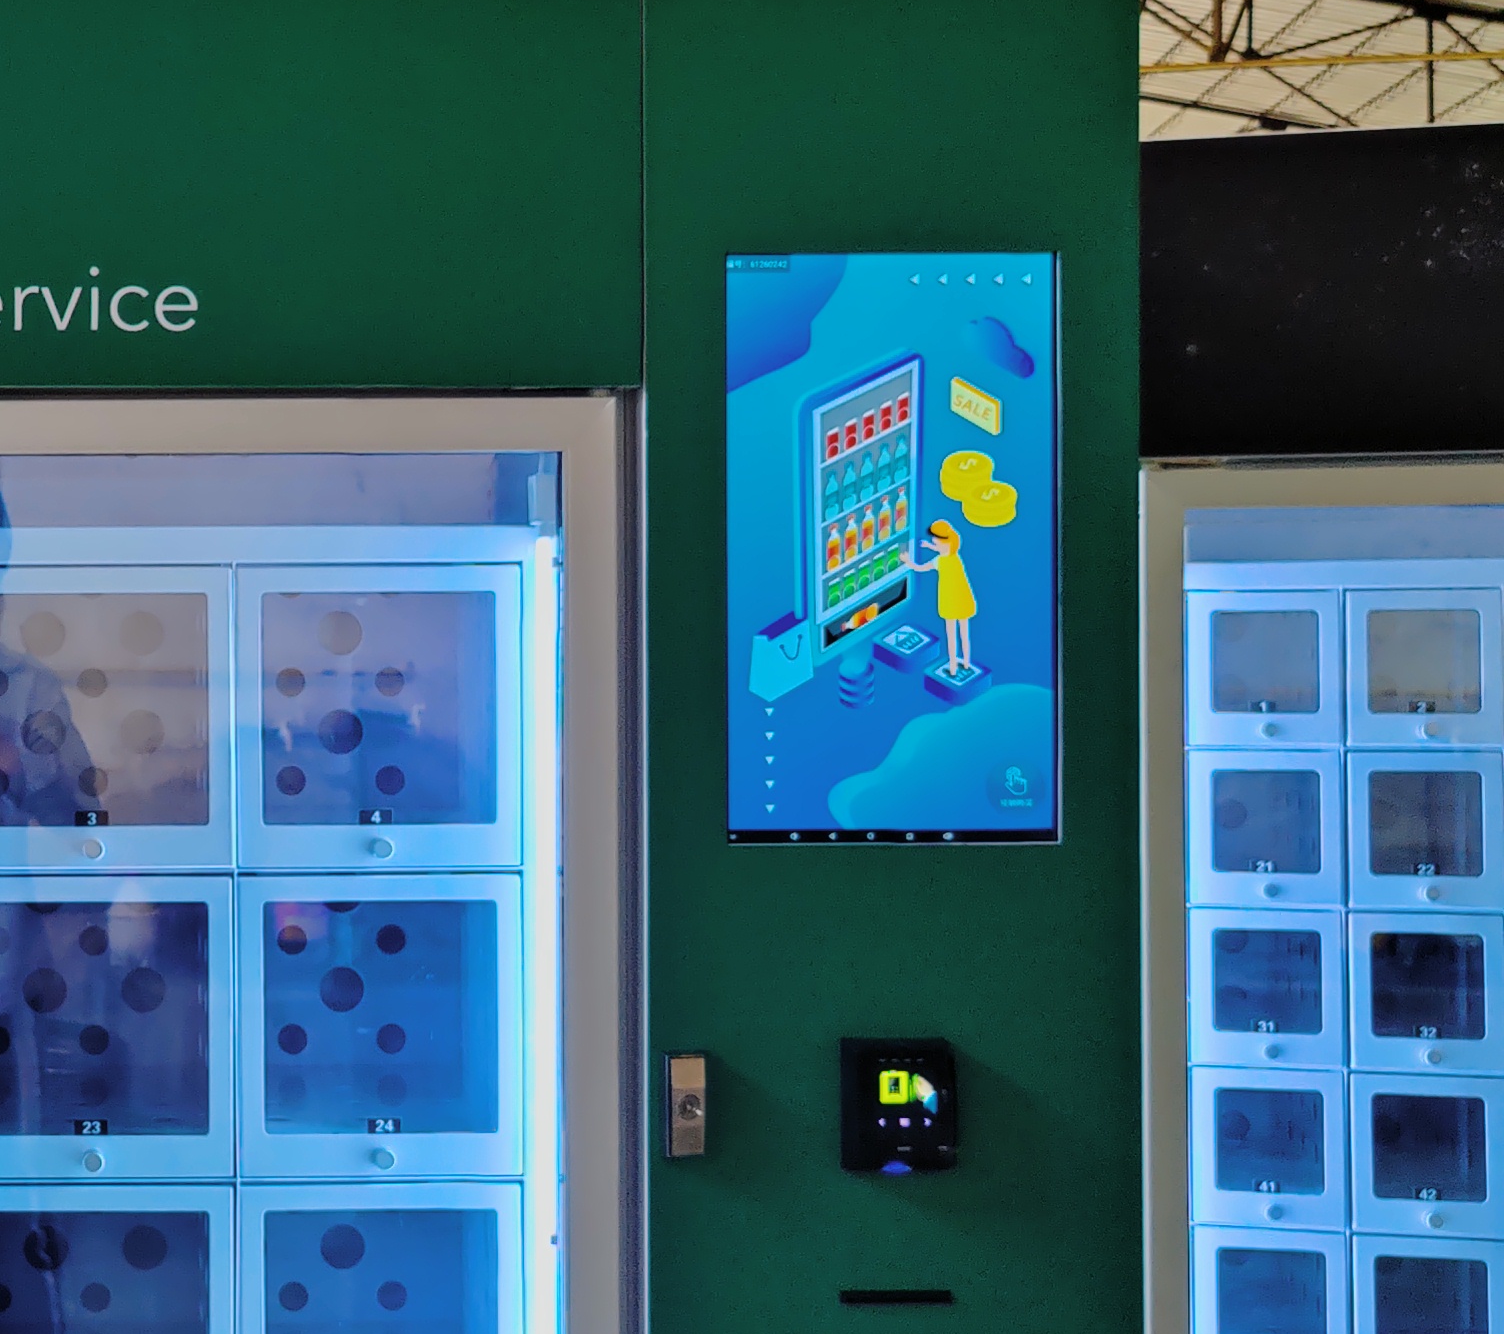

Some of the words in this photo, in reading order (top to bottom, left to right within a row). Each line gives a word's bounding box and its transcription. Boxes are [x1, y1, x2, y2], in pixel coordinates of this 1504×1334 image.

[953, 394, 992, 421] SALE
[1260, 701, 1267, 712] 1
[1417, 701, 1426, 712] 2
[87, 813, 97, 824] 3
[371, 811, 380, 823] 4
[1256, 861, 1272, 871] 21
[1417, 863, 1435, 875] 22
[1258, 1021, 1274, 1031] 31
[1419, 1026, 1437, 1037] 32
[82, 1121, 101, 1134] 23
[375, 1119, 393, 1132] 24
[1259, 1181, 1275, 1192] 41
[1419, 1188, 1437, 1200] 42
